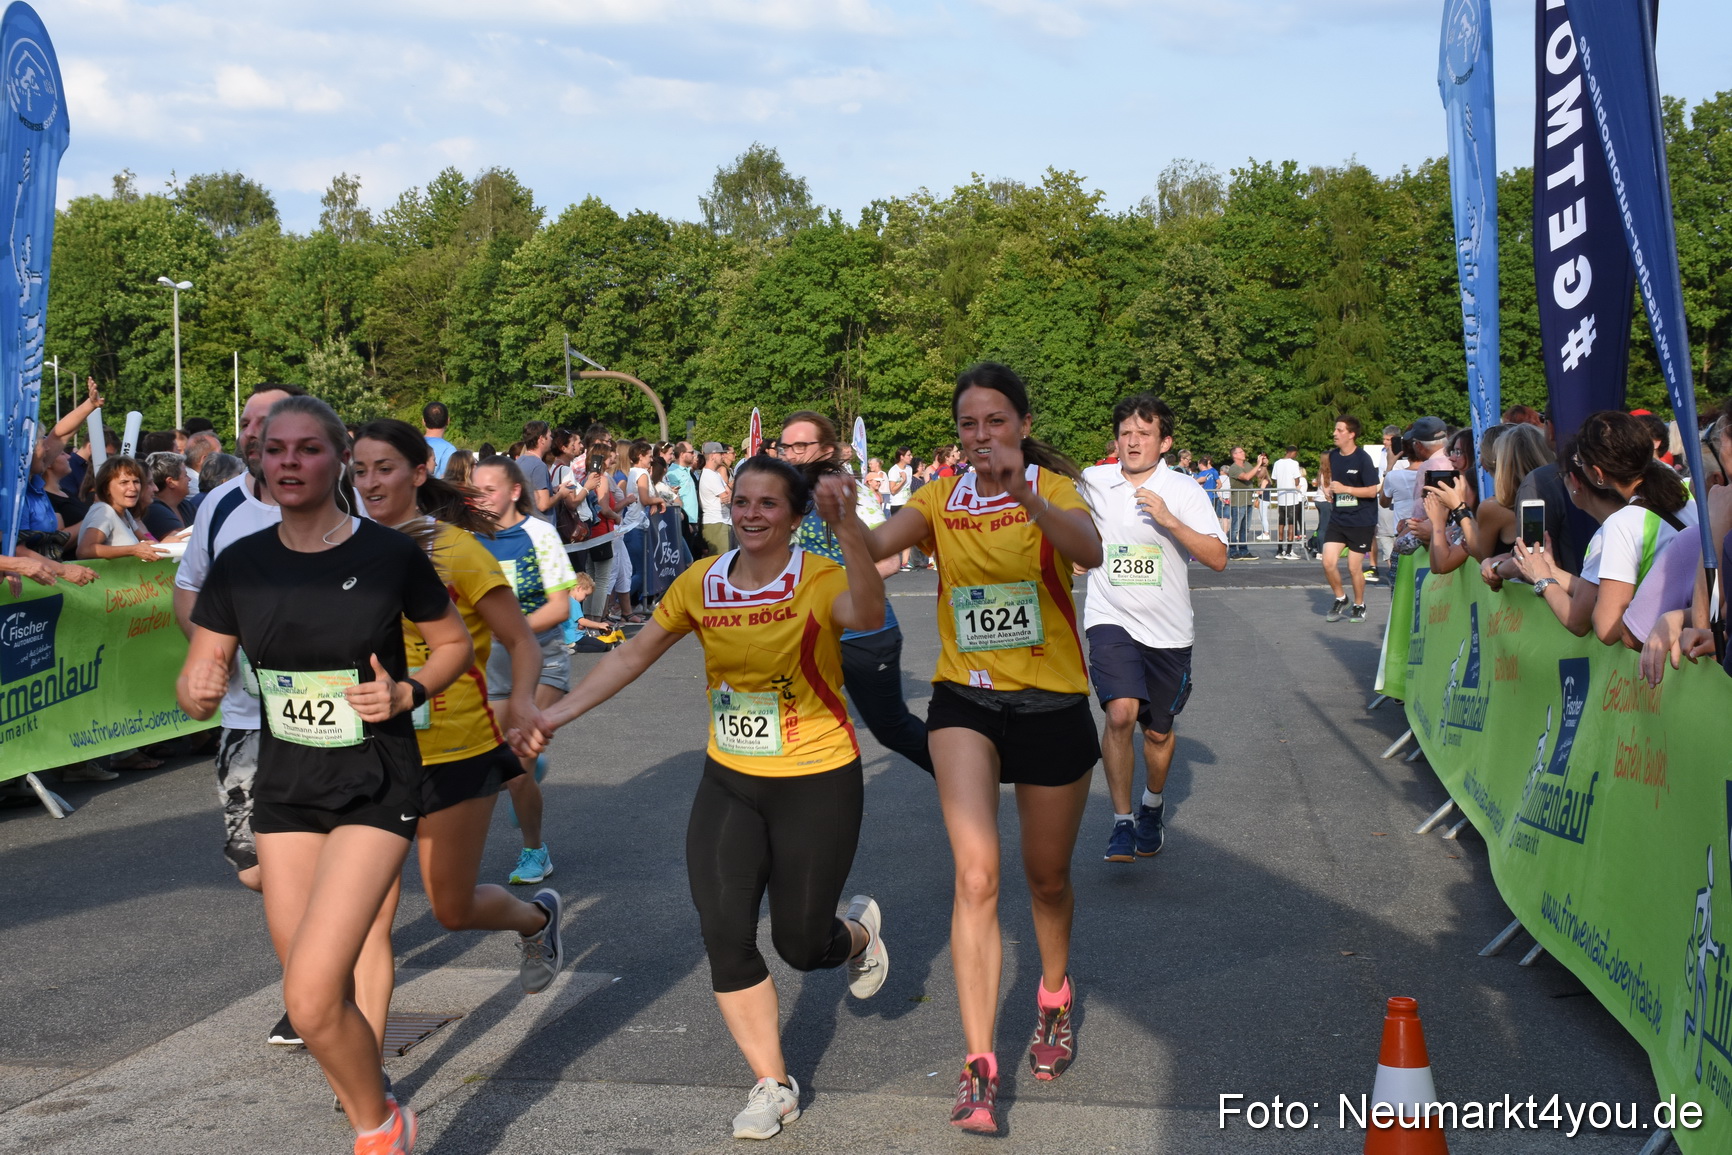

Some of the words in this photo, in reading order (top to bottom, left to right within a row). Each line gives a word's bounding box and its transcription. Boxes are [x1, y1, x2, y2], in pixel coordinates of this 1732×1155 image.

[943, 518, 983, 533] MAX
[1112, 559, 1154, 574] 2388
[154, 571, 175, 595] Fir
[127, 605, 171, 638] laufen
[702, 614, 742, 628] MAX
[748, 606, 798, 626] BÖGL
[965, 606, 1030, 633] 1624
[10, 620, 49, 641] Fischer
[13, 634, 44, 648] AUTOMOBILE
[966, 632, 996, 641] Lehmeier
[997, 629, 1032, 638] Alexandra
[282, 699, 336, 726] 442
[69, 701, 192, 749] www.firmenlauf-oberpfa
[313, 726, 343, 734] Jasmin
[719, 713, 769, 738] 1562
